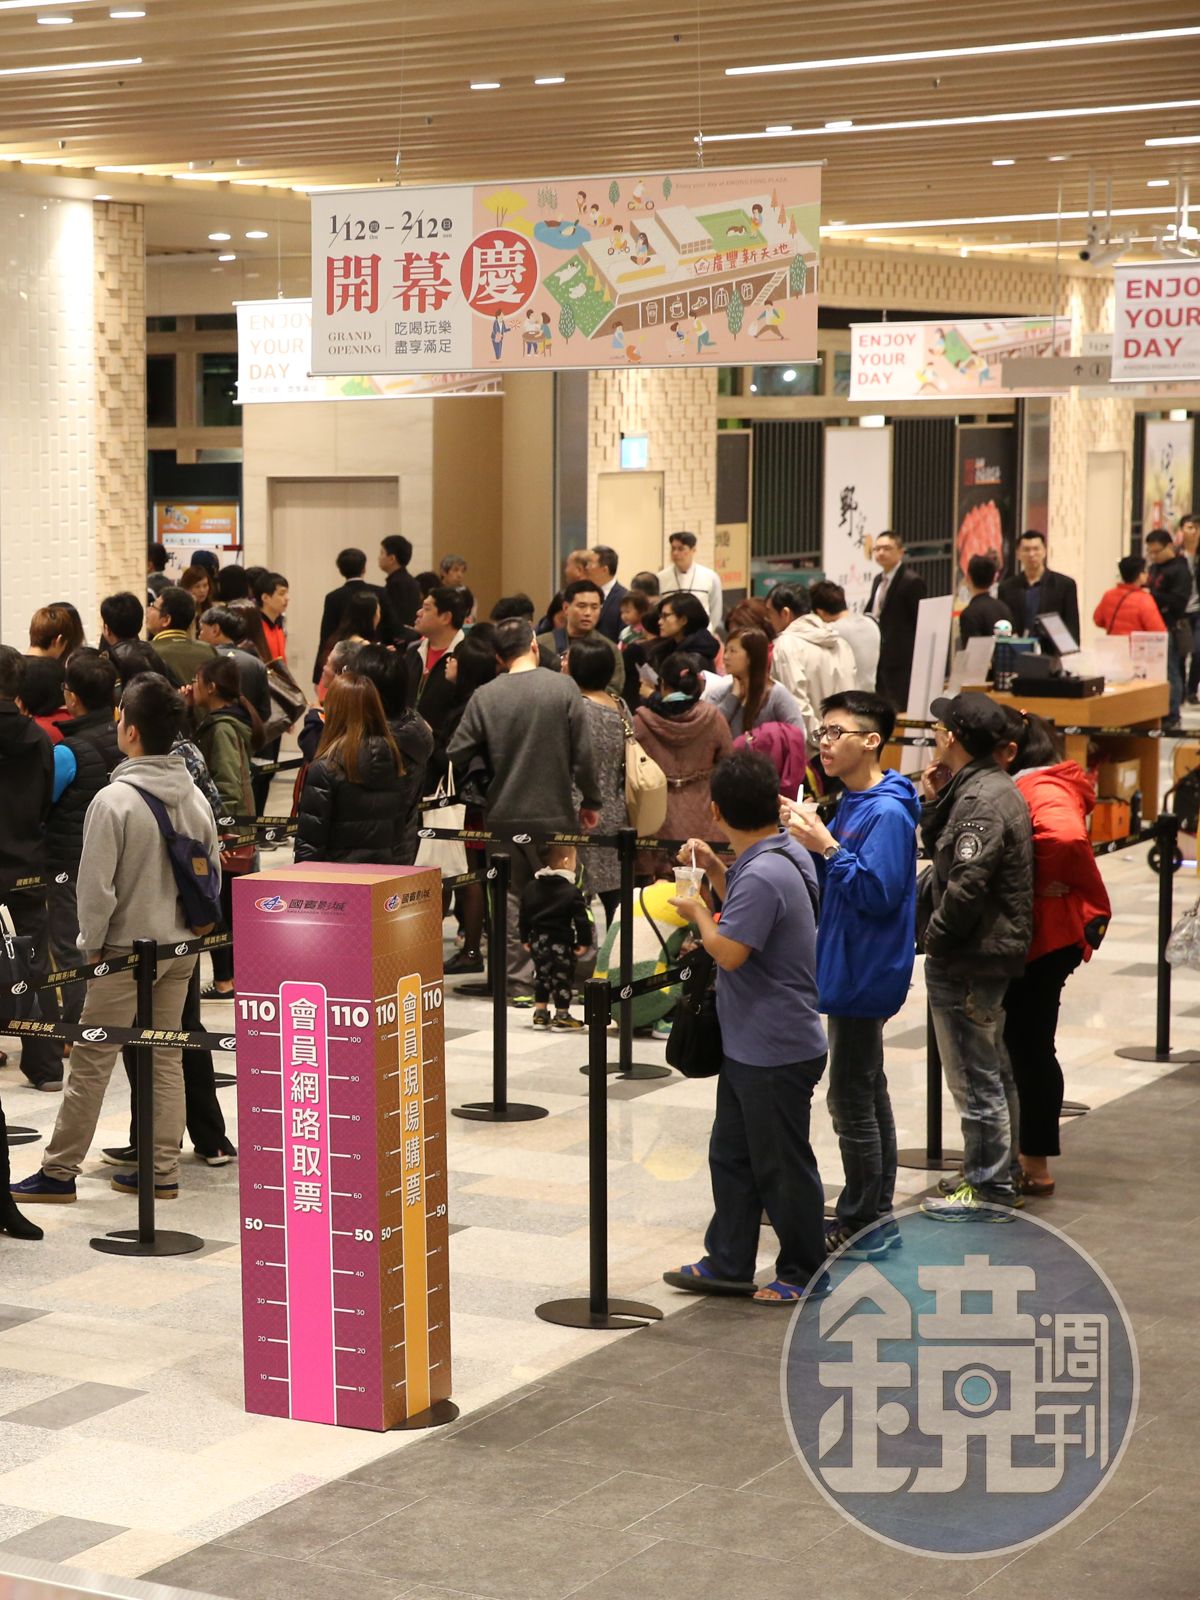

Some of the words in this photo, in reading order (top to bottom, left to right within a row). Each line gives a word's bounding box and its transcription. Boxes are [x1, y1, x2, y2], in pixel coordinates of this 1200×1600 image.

[712, 242, 790, 272] 廣豐新天地
[326, 239, 528, 316] 開幕慶
[1124, 307, 1200, 328] YOUR
[394, 320, 452, 336] 吃喝玩樂
[328, 331, 372, 342] GRAND
[859, 333, 916, 347] ENJOY
[250, 337, 304, 355] YOUR
[328, 344, 381, 355] OPENING
[394, 339, 452, 355] 盡享滿足
[1123, 337, 1182, 359] DAY
[858, 352, 905, 366] YOUR
[249, 363, 290, 380] DAY
[858, 372, 893, 385] DAY
[288, 898, 348, 912] 國賓影城
[423, 987, 442, 1011] 110
[238, 1000, 276, 1021] 110
[331, 1005, 370, 1027] 110
[376, 1002, 397, 1026] 110
[8, 1019, 56, 1033] 國賓影城
[141, 1029, 191, 1042] 國賓影城
[288, 997, 324, 1213] 會員網路取票
[402, 991, 422, 1207] 會員現場購票
[436, 1203, 446, 1217] 50
[245, 1218, 263, 1231] 50
[354, 1229, 374, 1242] 50
[381, 1226, 391, 1240] 50
